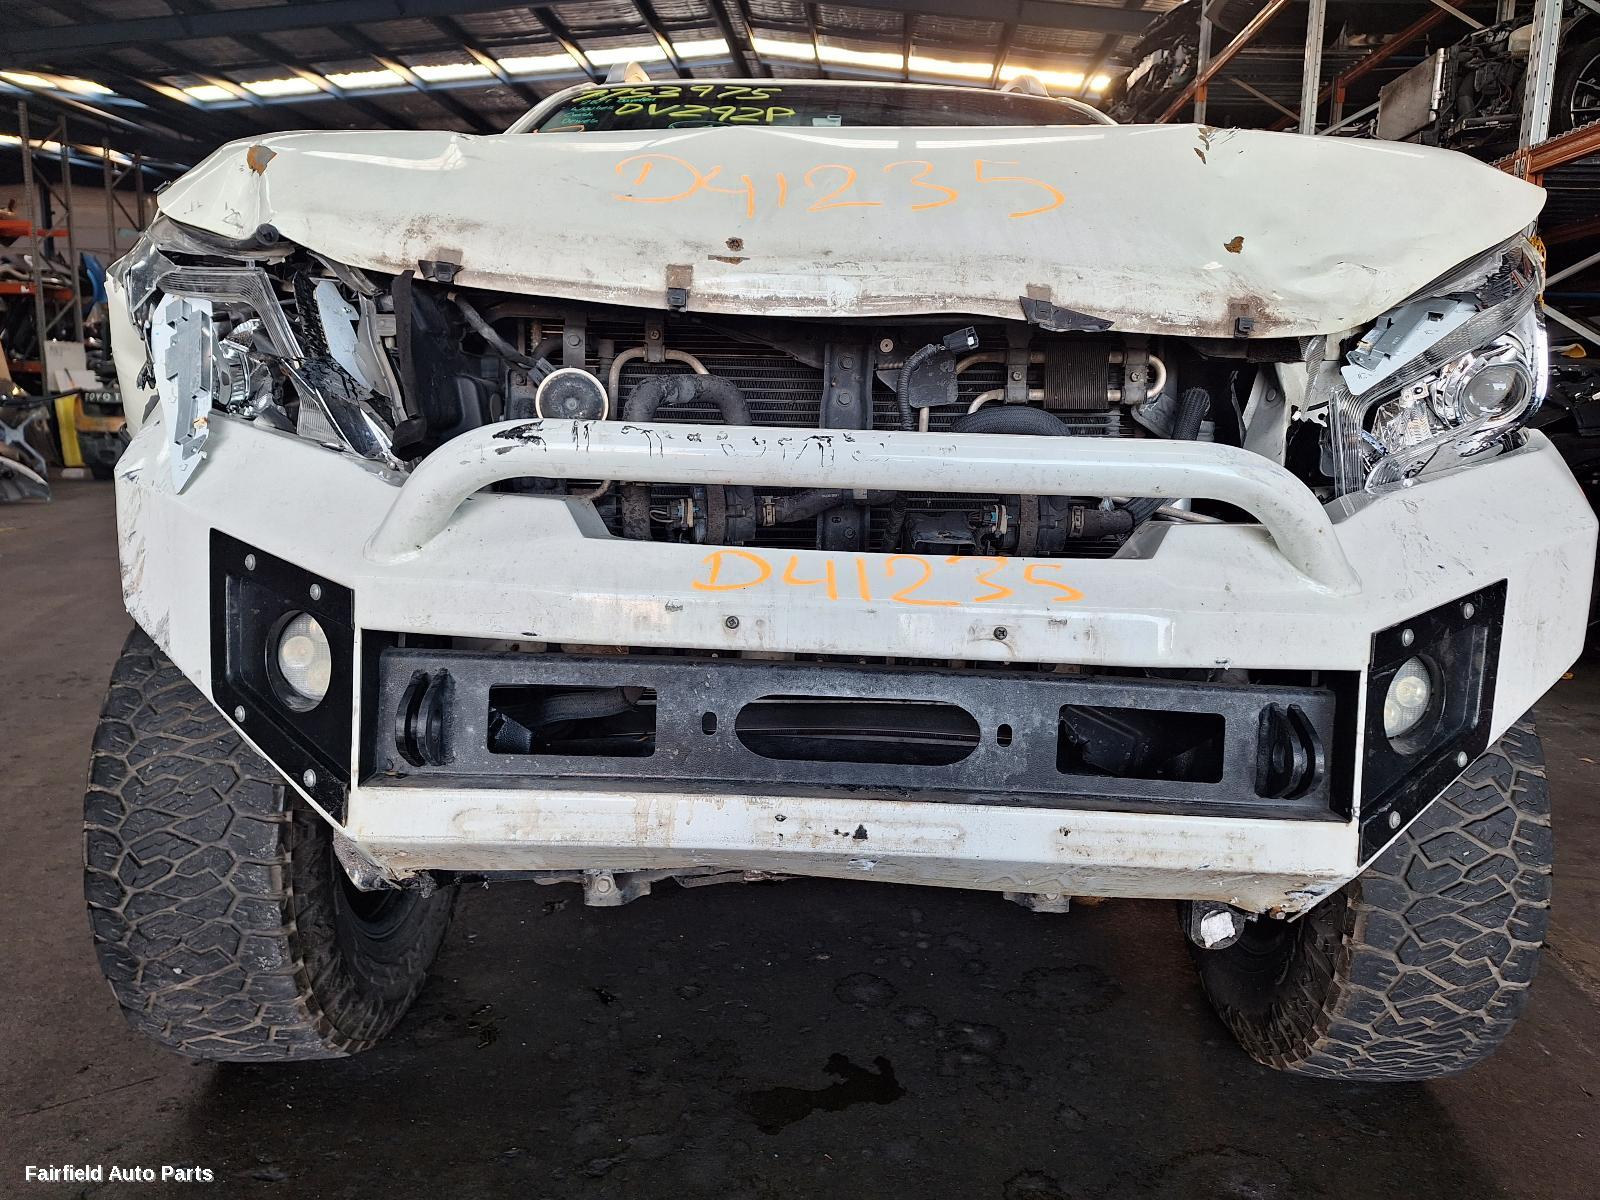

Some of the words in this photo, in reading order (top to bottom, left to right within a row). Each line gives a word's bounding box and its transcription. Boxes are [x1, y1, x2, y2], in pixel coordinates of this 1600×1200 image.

[613, 153, 1066, 219] D41235
[84, 392, 121, 401] TOYOT
[691, 549, 1086, 608] D41235
